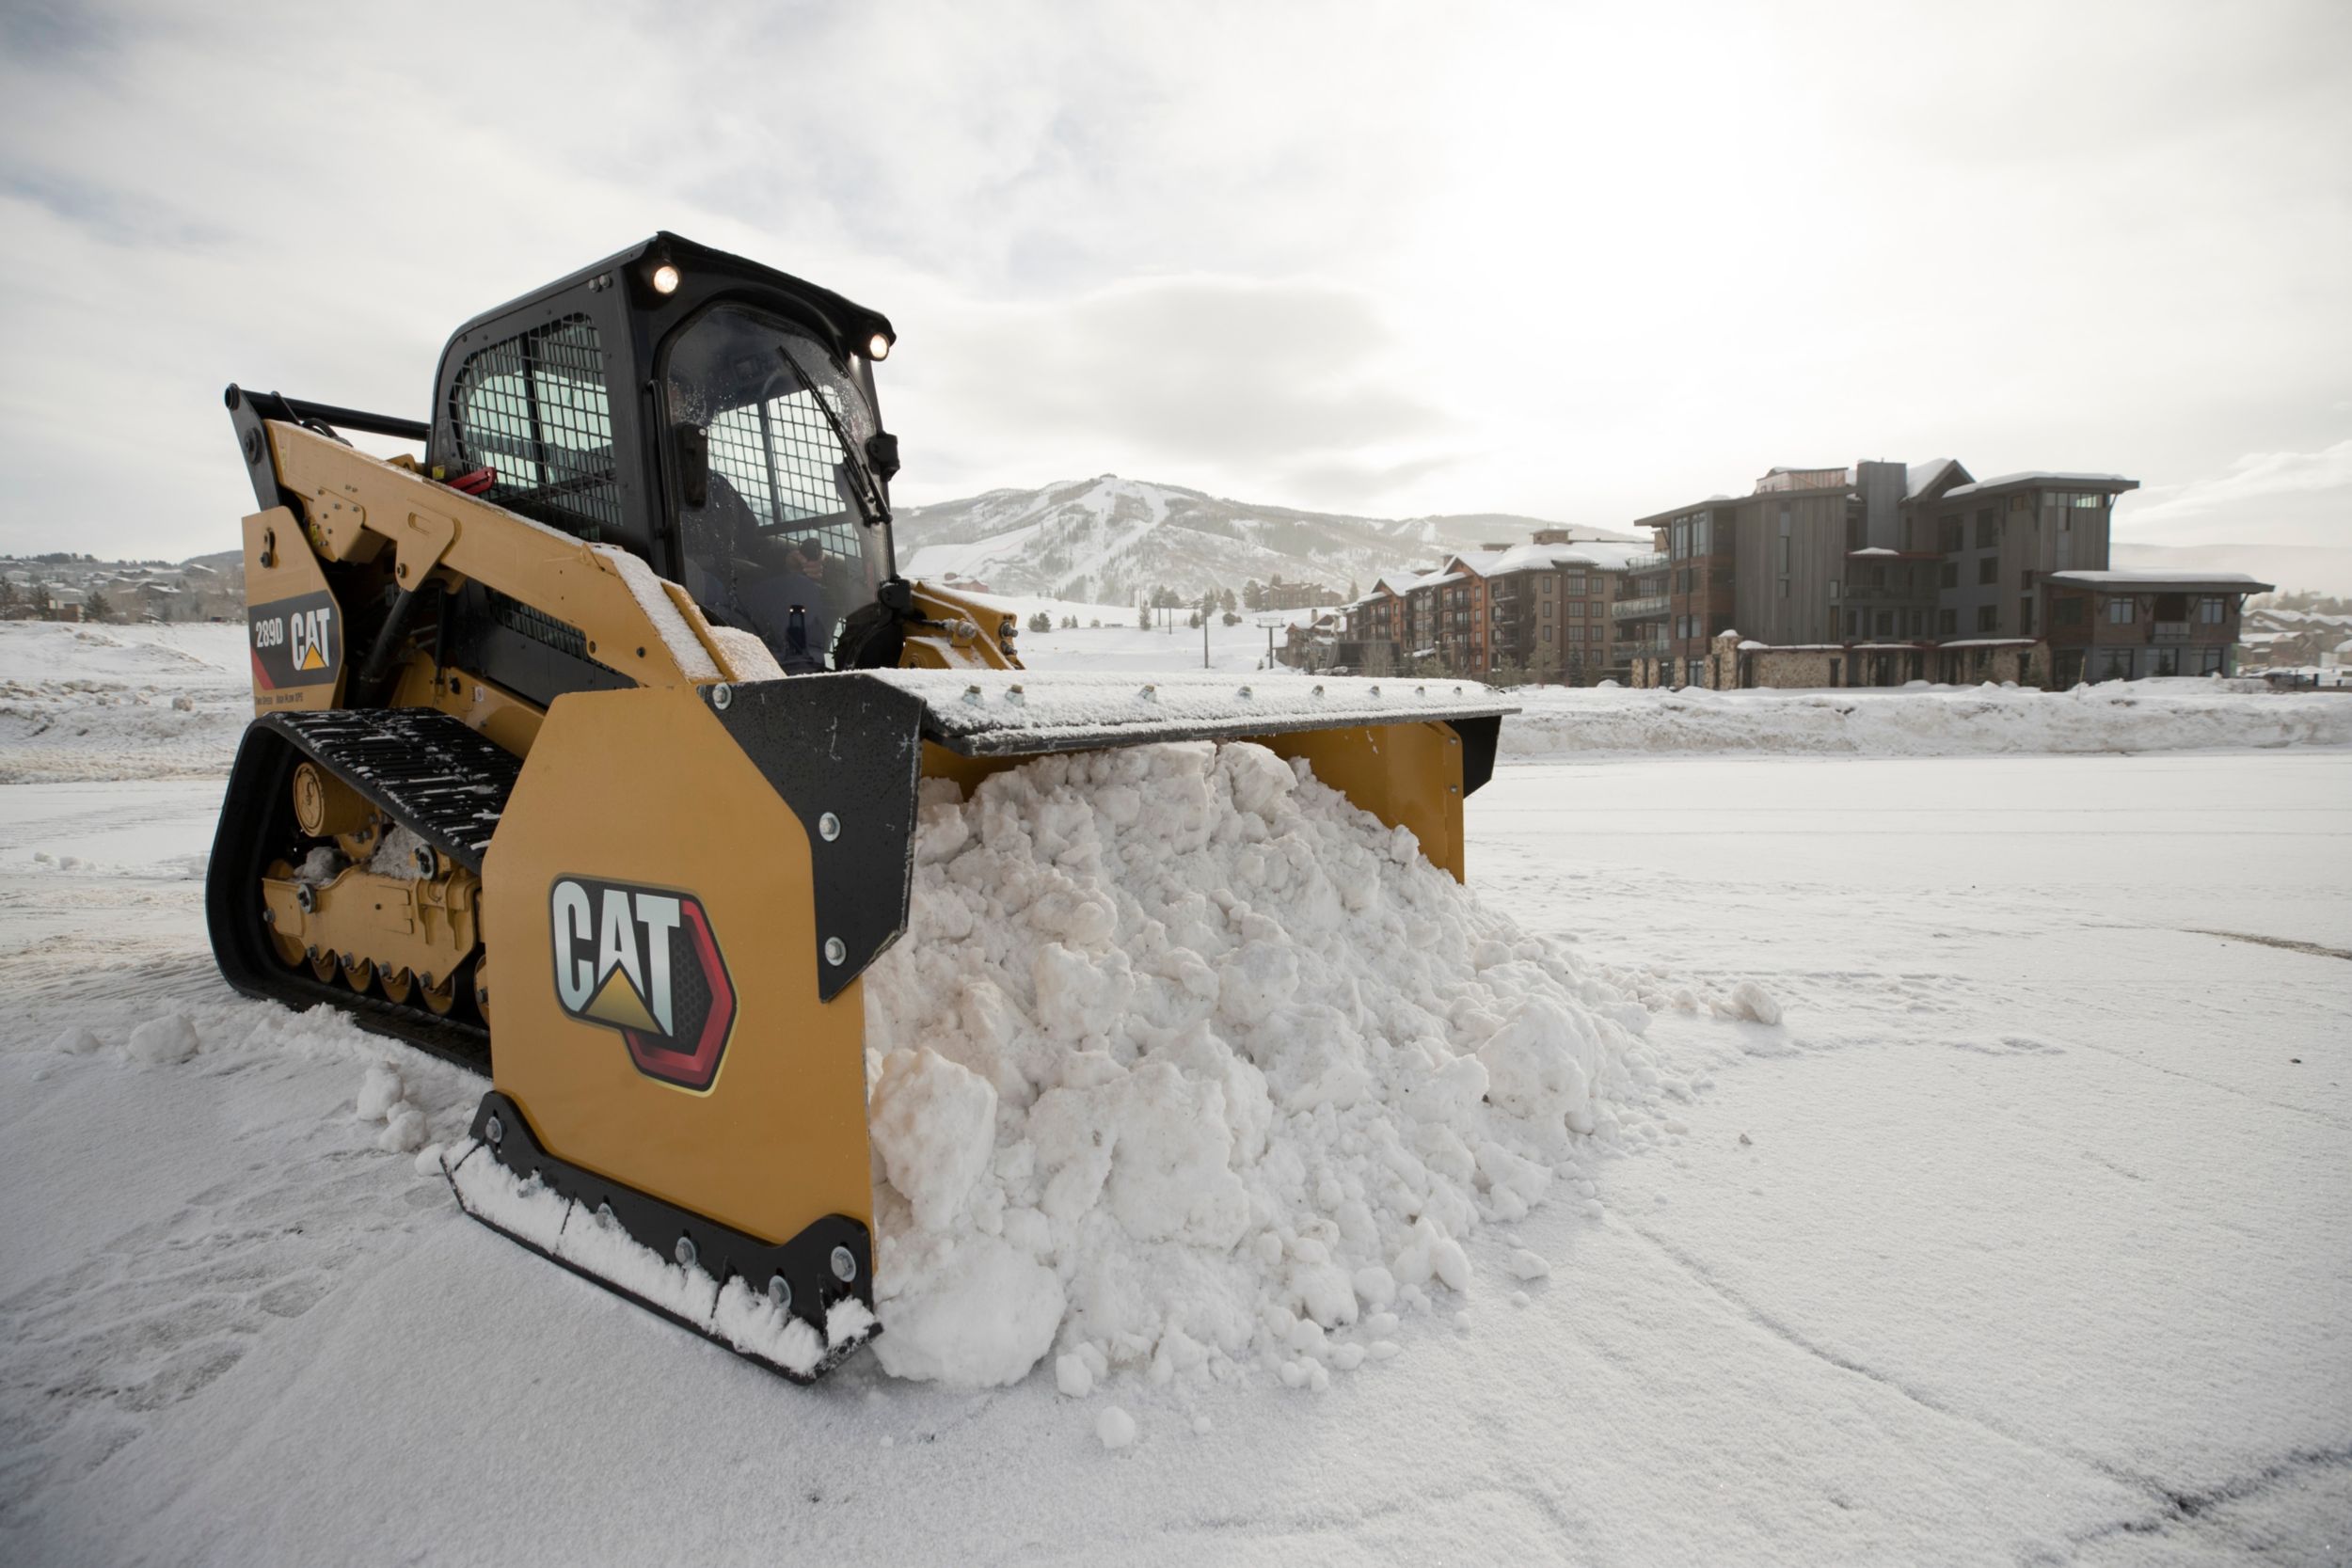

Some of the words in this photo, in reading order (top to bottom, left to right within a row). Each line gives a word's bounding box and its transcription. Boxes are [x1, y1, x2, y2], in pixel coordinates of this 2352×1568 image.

[256, 617, 283, 648] 289D
[291, 608, 330, 671] CAT
[552, 880, 681, 1037] CAT
